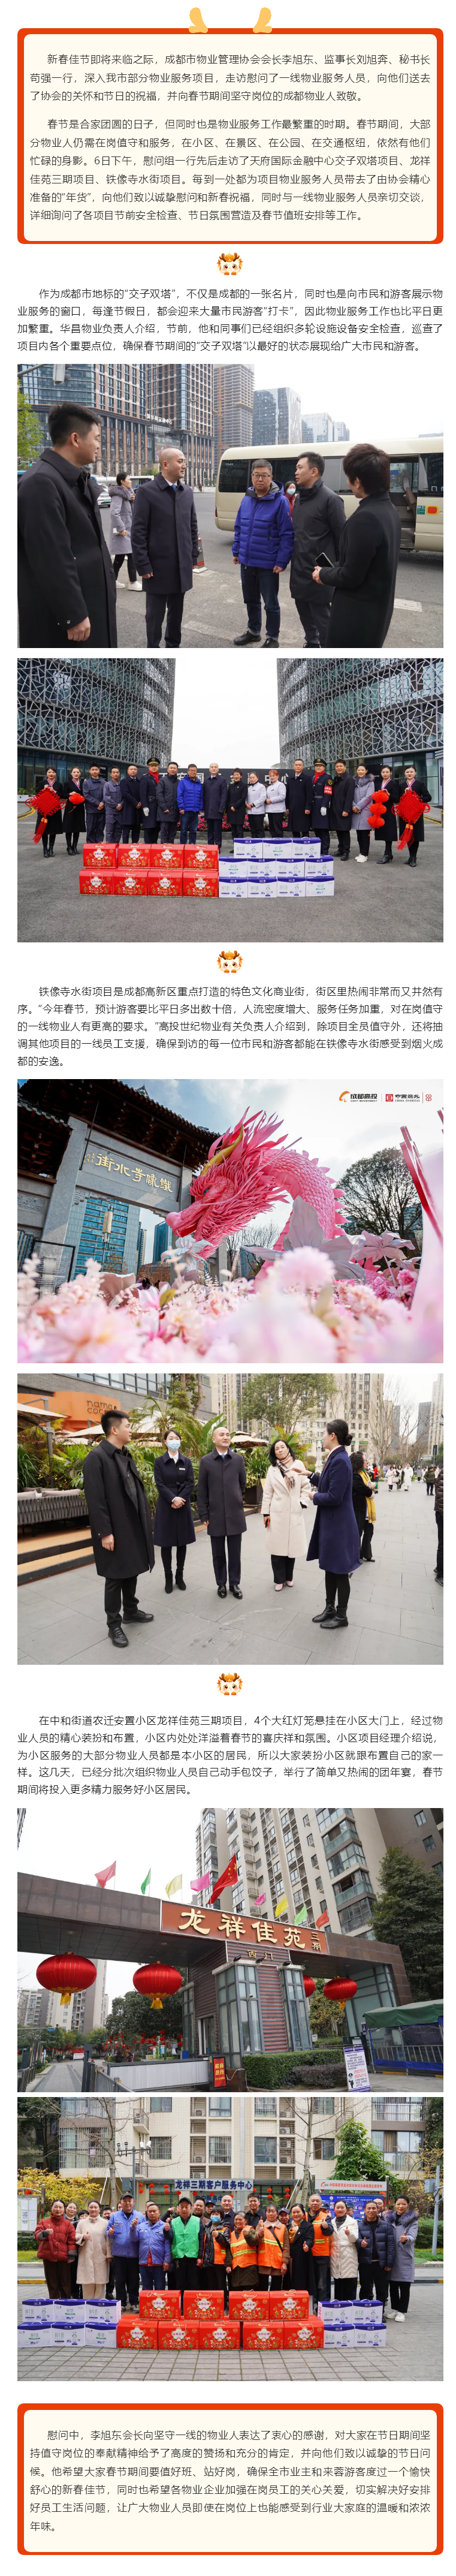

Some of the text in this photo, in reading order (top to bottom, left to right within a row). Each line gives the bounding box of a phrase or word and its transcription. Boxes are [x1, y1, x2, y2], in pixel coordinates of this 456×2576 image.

[87, 1400, 113, 1409] nama
[178, 1908, 306, 1949] 龙祥佳苑
[310, 1932, 322, 1951] 三期
[247, 1950, 274, 1960] 西门
[175, 2180, 253, 2190] 龙祥三期客户服务中心
